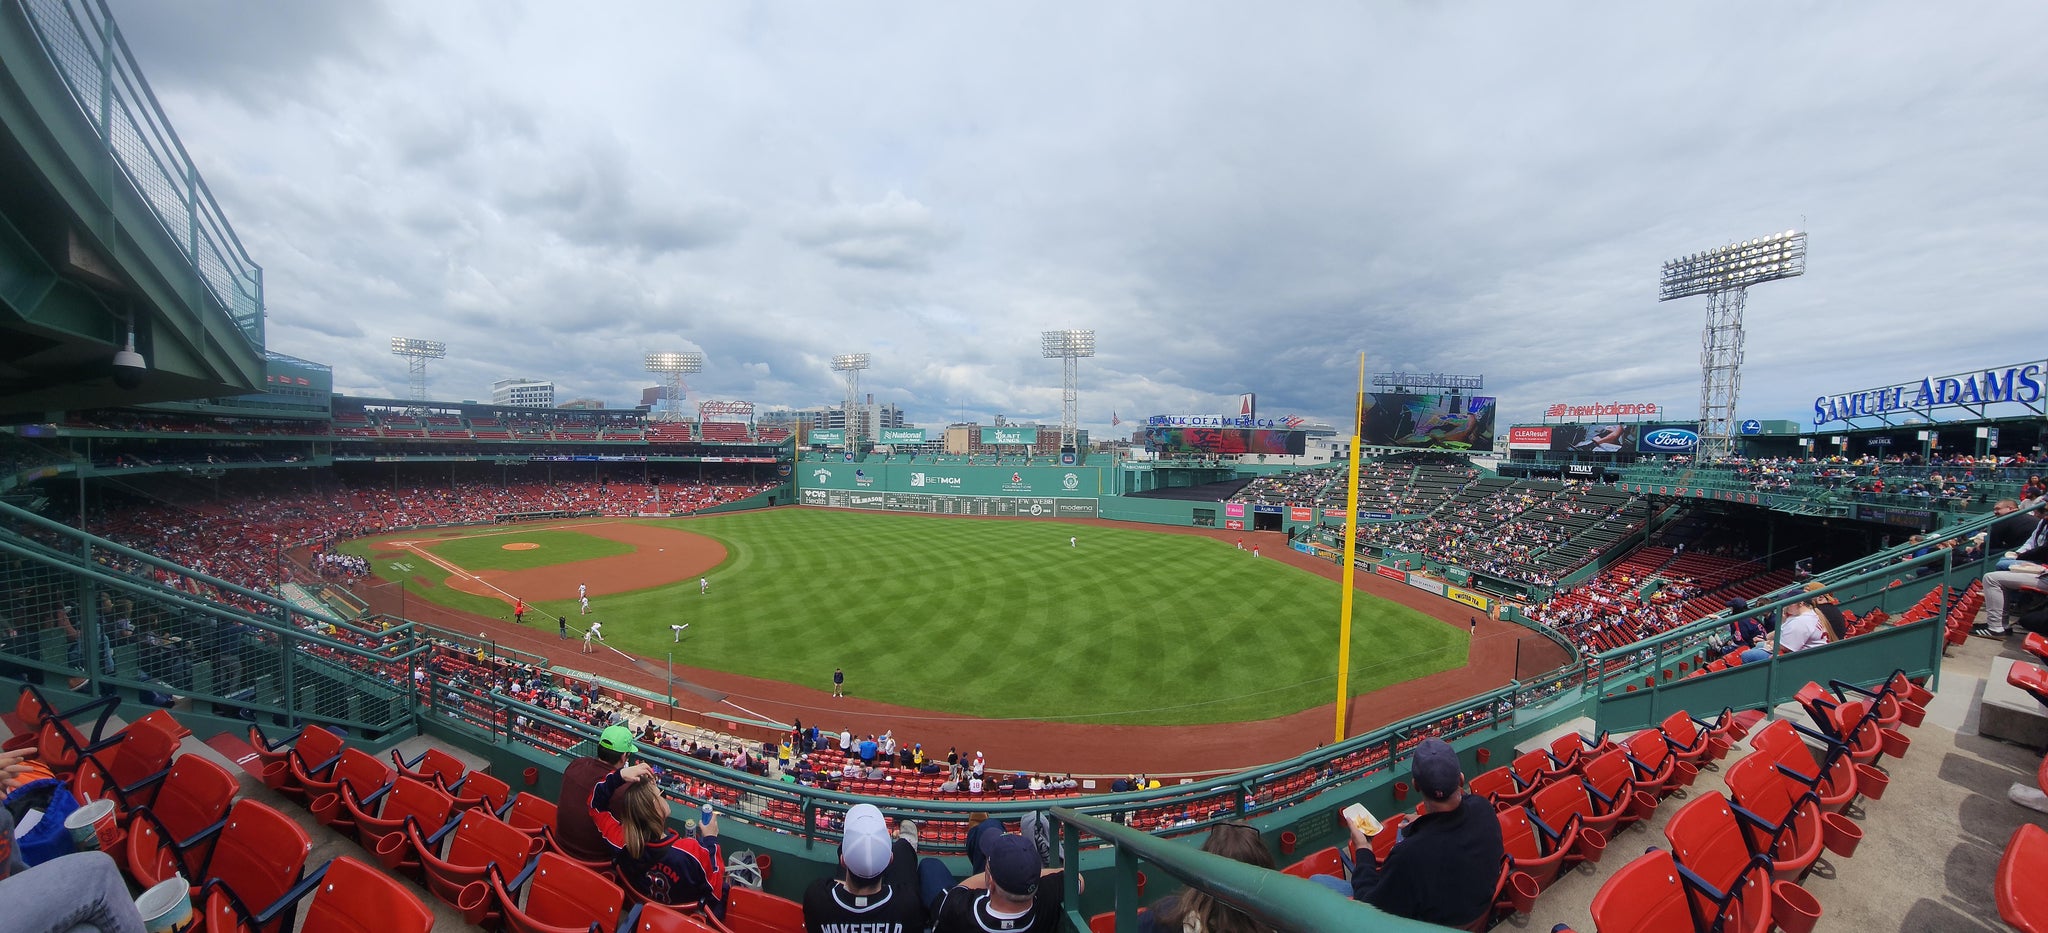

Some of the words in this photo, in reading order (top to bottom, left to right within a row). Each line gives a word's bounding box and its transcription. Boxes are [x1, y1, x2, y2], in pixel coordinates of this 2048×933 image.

[1391, 371, 1484, 389] MassMutual
[1813, 385, 1907, 425] SAMUEL
[1914, 364, 2044, 406] ADAMS
[1595, 401, 1657, 415] balance
[1150, 417, 1186, 425] BANK
[1192, 417, 1208, 425] OF
[1212, 417, 1274, 427] AMERICA
[892, 430, 922, 439] National
[994, 431, 1020, 439] DRAFT
[1515, 430, 1548, 438] CLEAResult
[1659, 432, 1688, 446] Ford
[1569, 464, 1593, 472] TRULY
[926, 476, 961, 486] BETMGM
[812, 490, 827, 498] CVS
[805, 496, 827, 505] Health
[1060, 504, 1093, 512] moderna
[1455, 593, 1471, 602] TWISTED
[820, 922, 904, 933] WAKEFIELD
